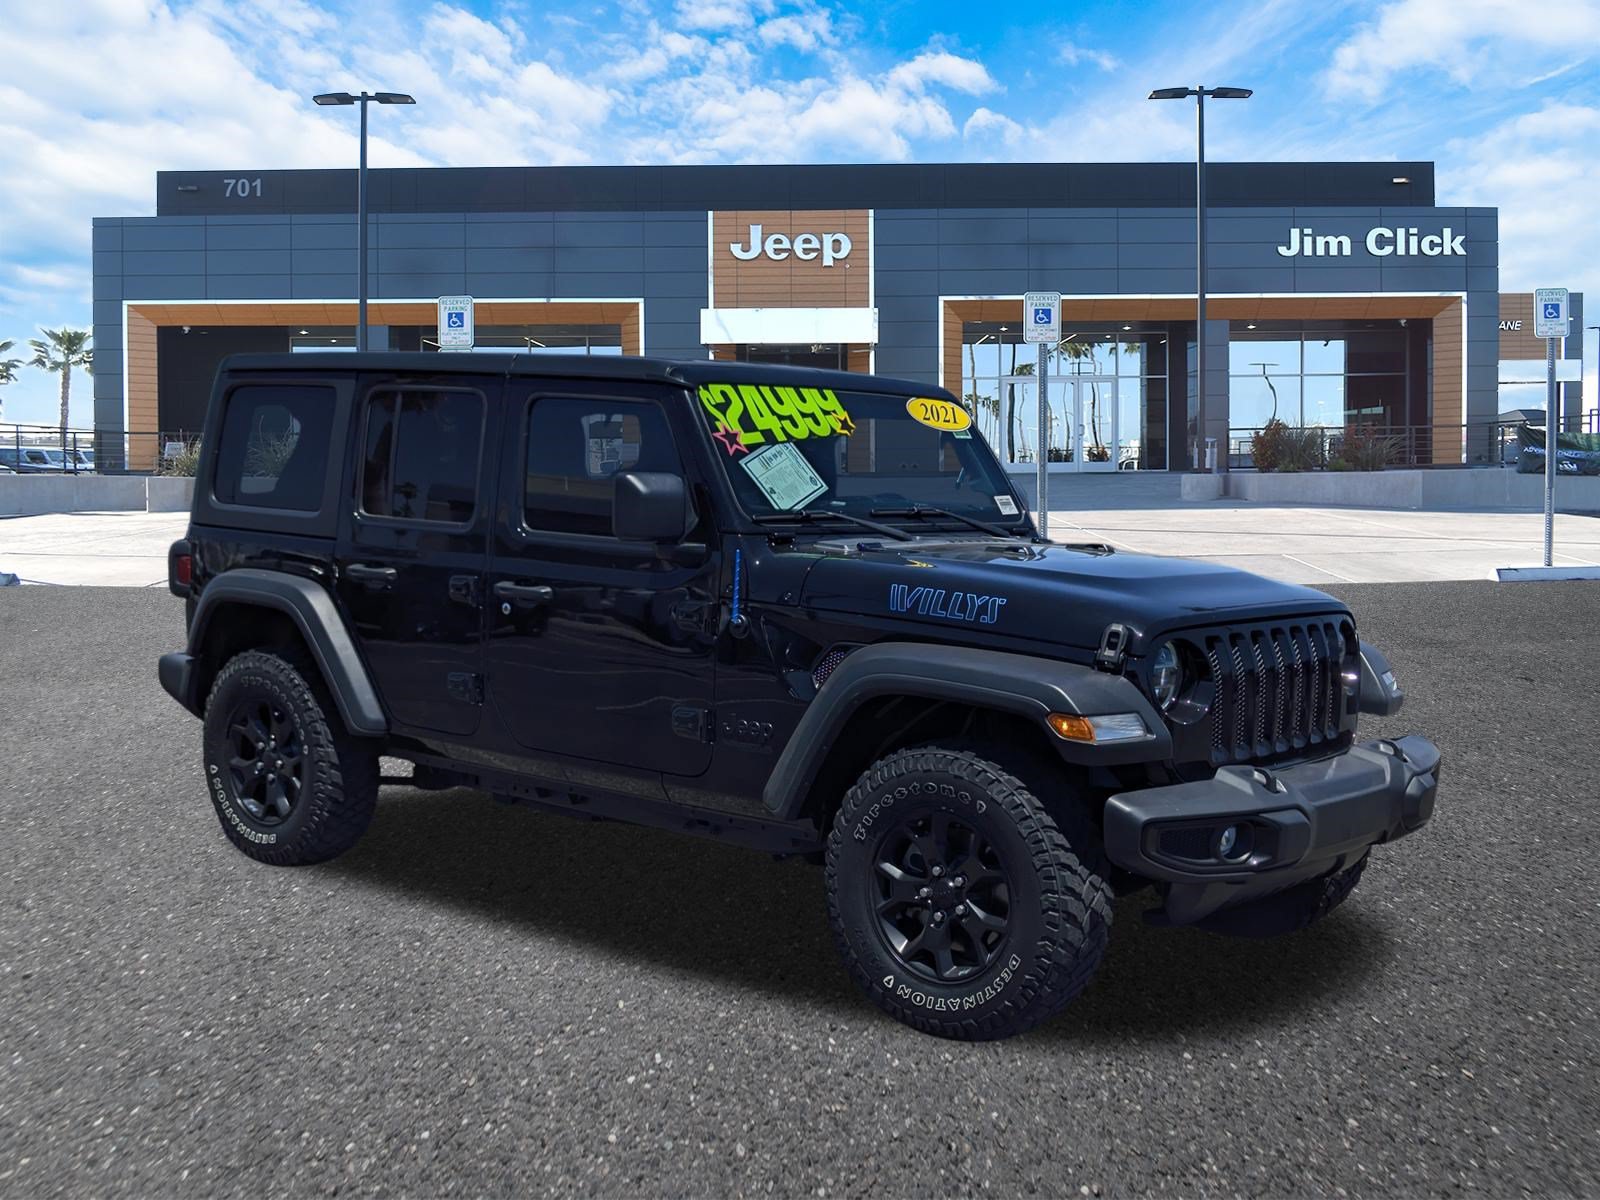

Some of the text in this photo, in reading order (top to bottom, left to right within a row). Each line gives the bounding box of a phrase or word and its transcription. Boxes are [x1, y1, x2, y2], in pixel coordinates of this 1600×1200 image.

[223, 178, 262, 197] 701
[729, 224, 852, 267] Jeep
[1277, 227, 1467, 257] Jim Click
[920, 402, 959, 424] 2021
[890, 583, 1007, 624] WILLYS
[212, 777, 277, 845] DESTINATION
[897, 954, 1021, 1011] DESTINATION
